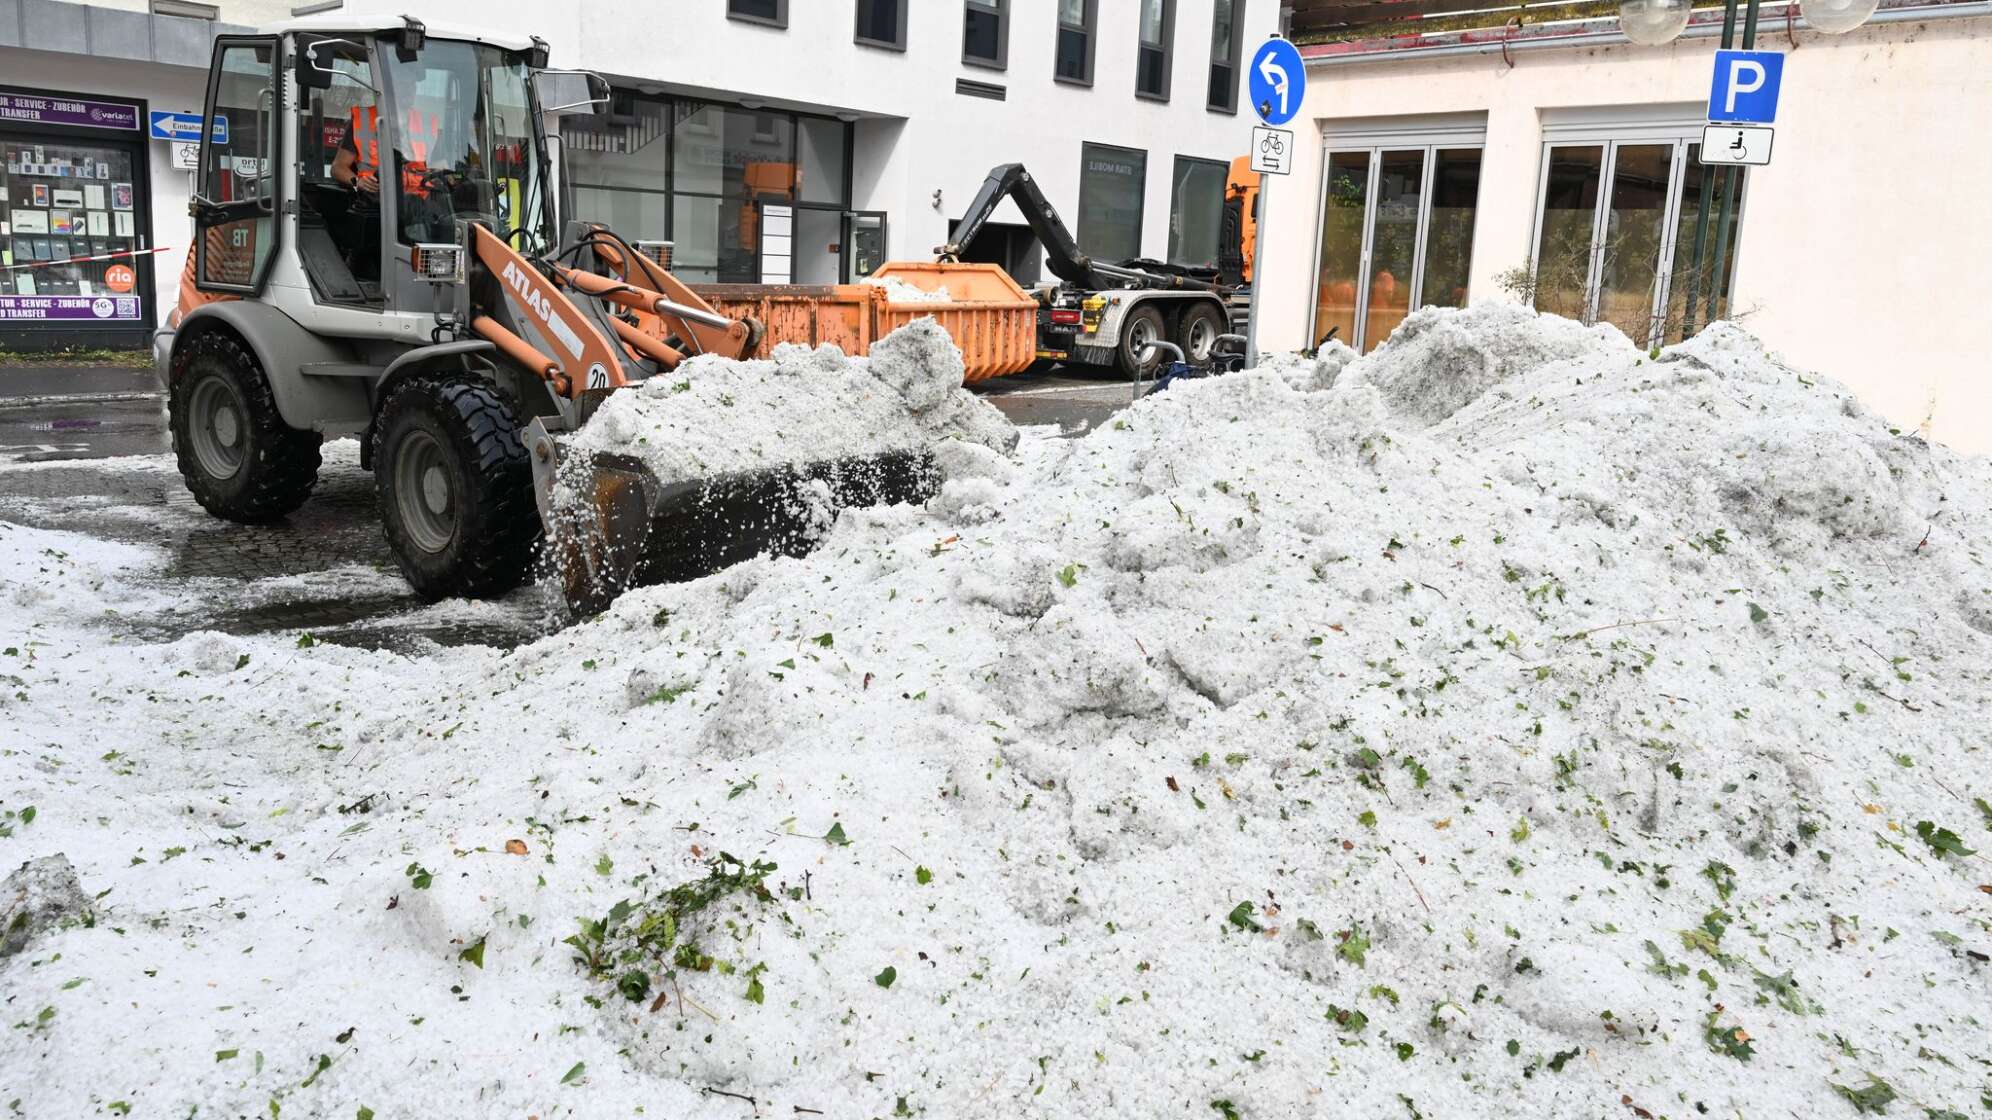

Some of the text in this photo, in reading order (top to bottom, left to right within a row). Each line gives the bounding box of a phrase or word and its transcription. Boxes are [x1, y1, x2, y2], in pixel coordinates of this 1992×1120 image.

[1725, 60, 1766, 113] P
[15, 98, 47, 110] SERVICE
[1, 107, 40, 120] TRANSFER
[109, 268, 132, 282] ria
[502, 260, 551, 322] ATLAS
[21, 299, 52, 308] SERVICE
[8, 309, 46, 318] TRANSFER
[590, 368, 606, 389] 20
